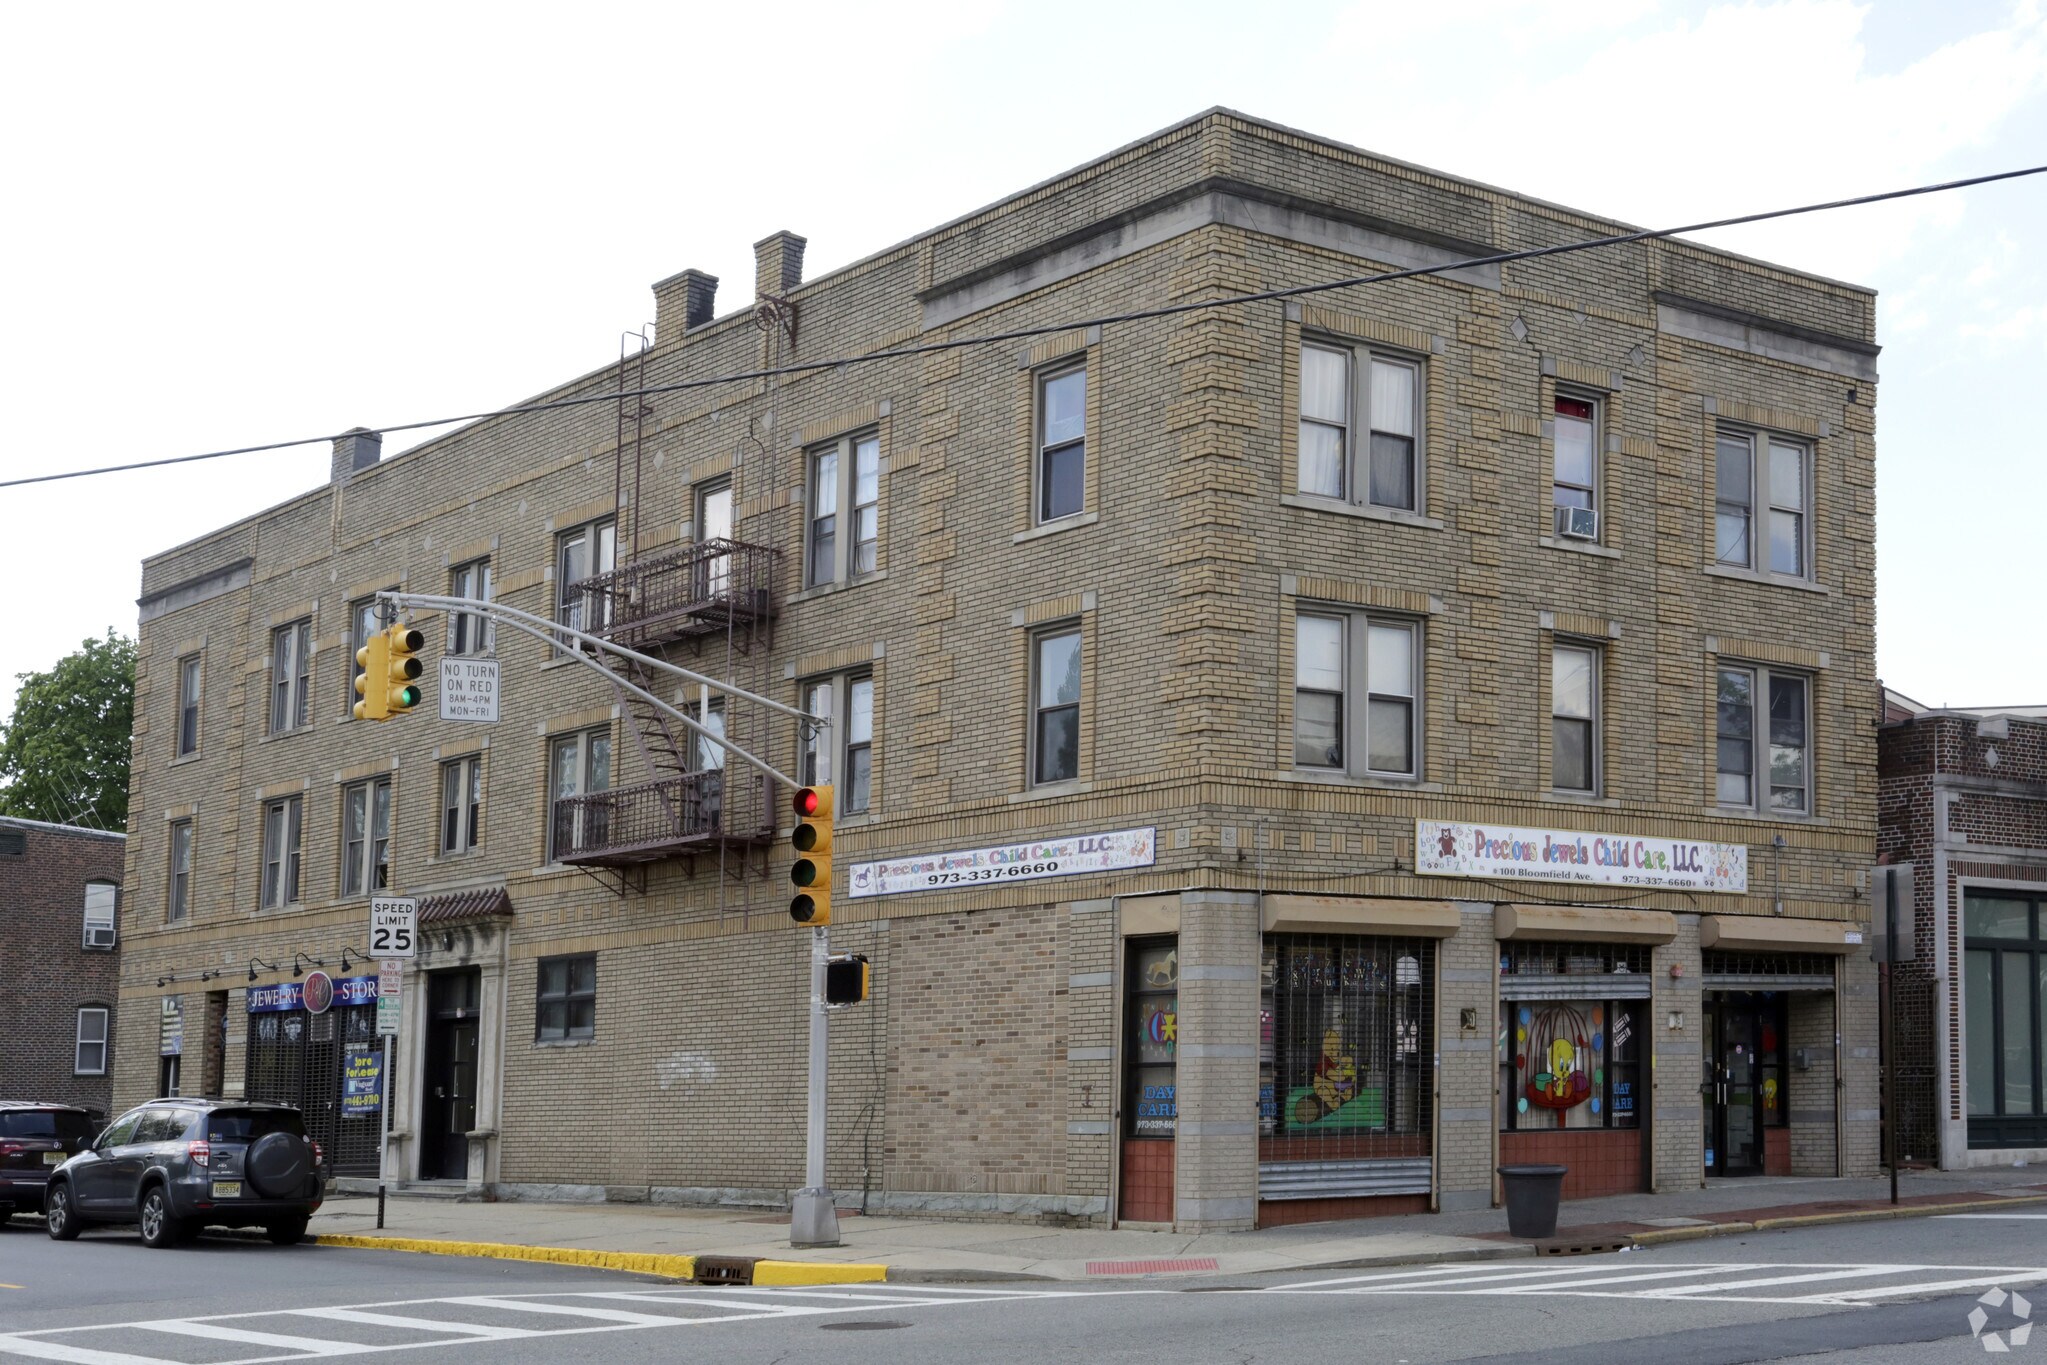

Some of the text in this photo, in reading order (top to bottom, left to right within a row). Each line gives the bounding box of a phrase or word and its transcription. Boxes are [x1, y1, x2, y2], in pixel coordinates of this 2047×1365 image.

[445, 664, 495, 678] NO TURN
[447, 679, 492, 693] ON RED
[449, 693, 490, 704] 8AM-4PM
[450, 706, 489, 716] MON-FRI
[878, 860, 935, 878] Precious
[938, 852, 985, 871] Jewels
[989, 847, 1027, 865] Child
[1078, 836, 1114, 854] LLC.
[1474, 829, 1703, 873] Precious Jewels Child Care, LLC.
[927, 861, 1058, 885] 973-337-6660
[1500, 868, 1593, 881] 100 Bloomfield Ave.
[1622, 875, 1692, 887] 973-337-6660
[374, 903, 413, 914] SPEED
[377, 916, 409, 926] LIMIT
[373, 928, 411, 951] 25
[387, 962, 396, 970] NO
[380, 969, 401, 977] PARKING
[251, 981, 380, 1007] JEWELRY STOR
[1144, 1086, 1176, 1099] DAY
[1613, 1097, 1633, 1109] ARE
